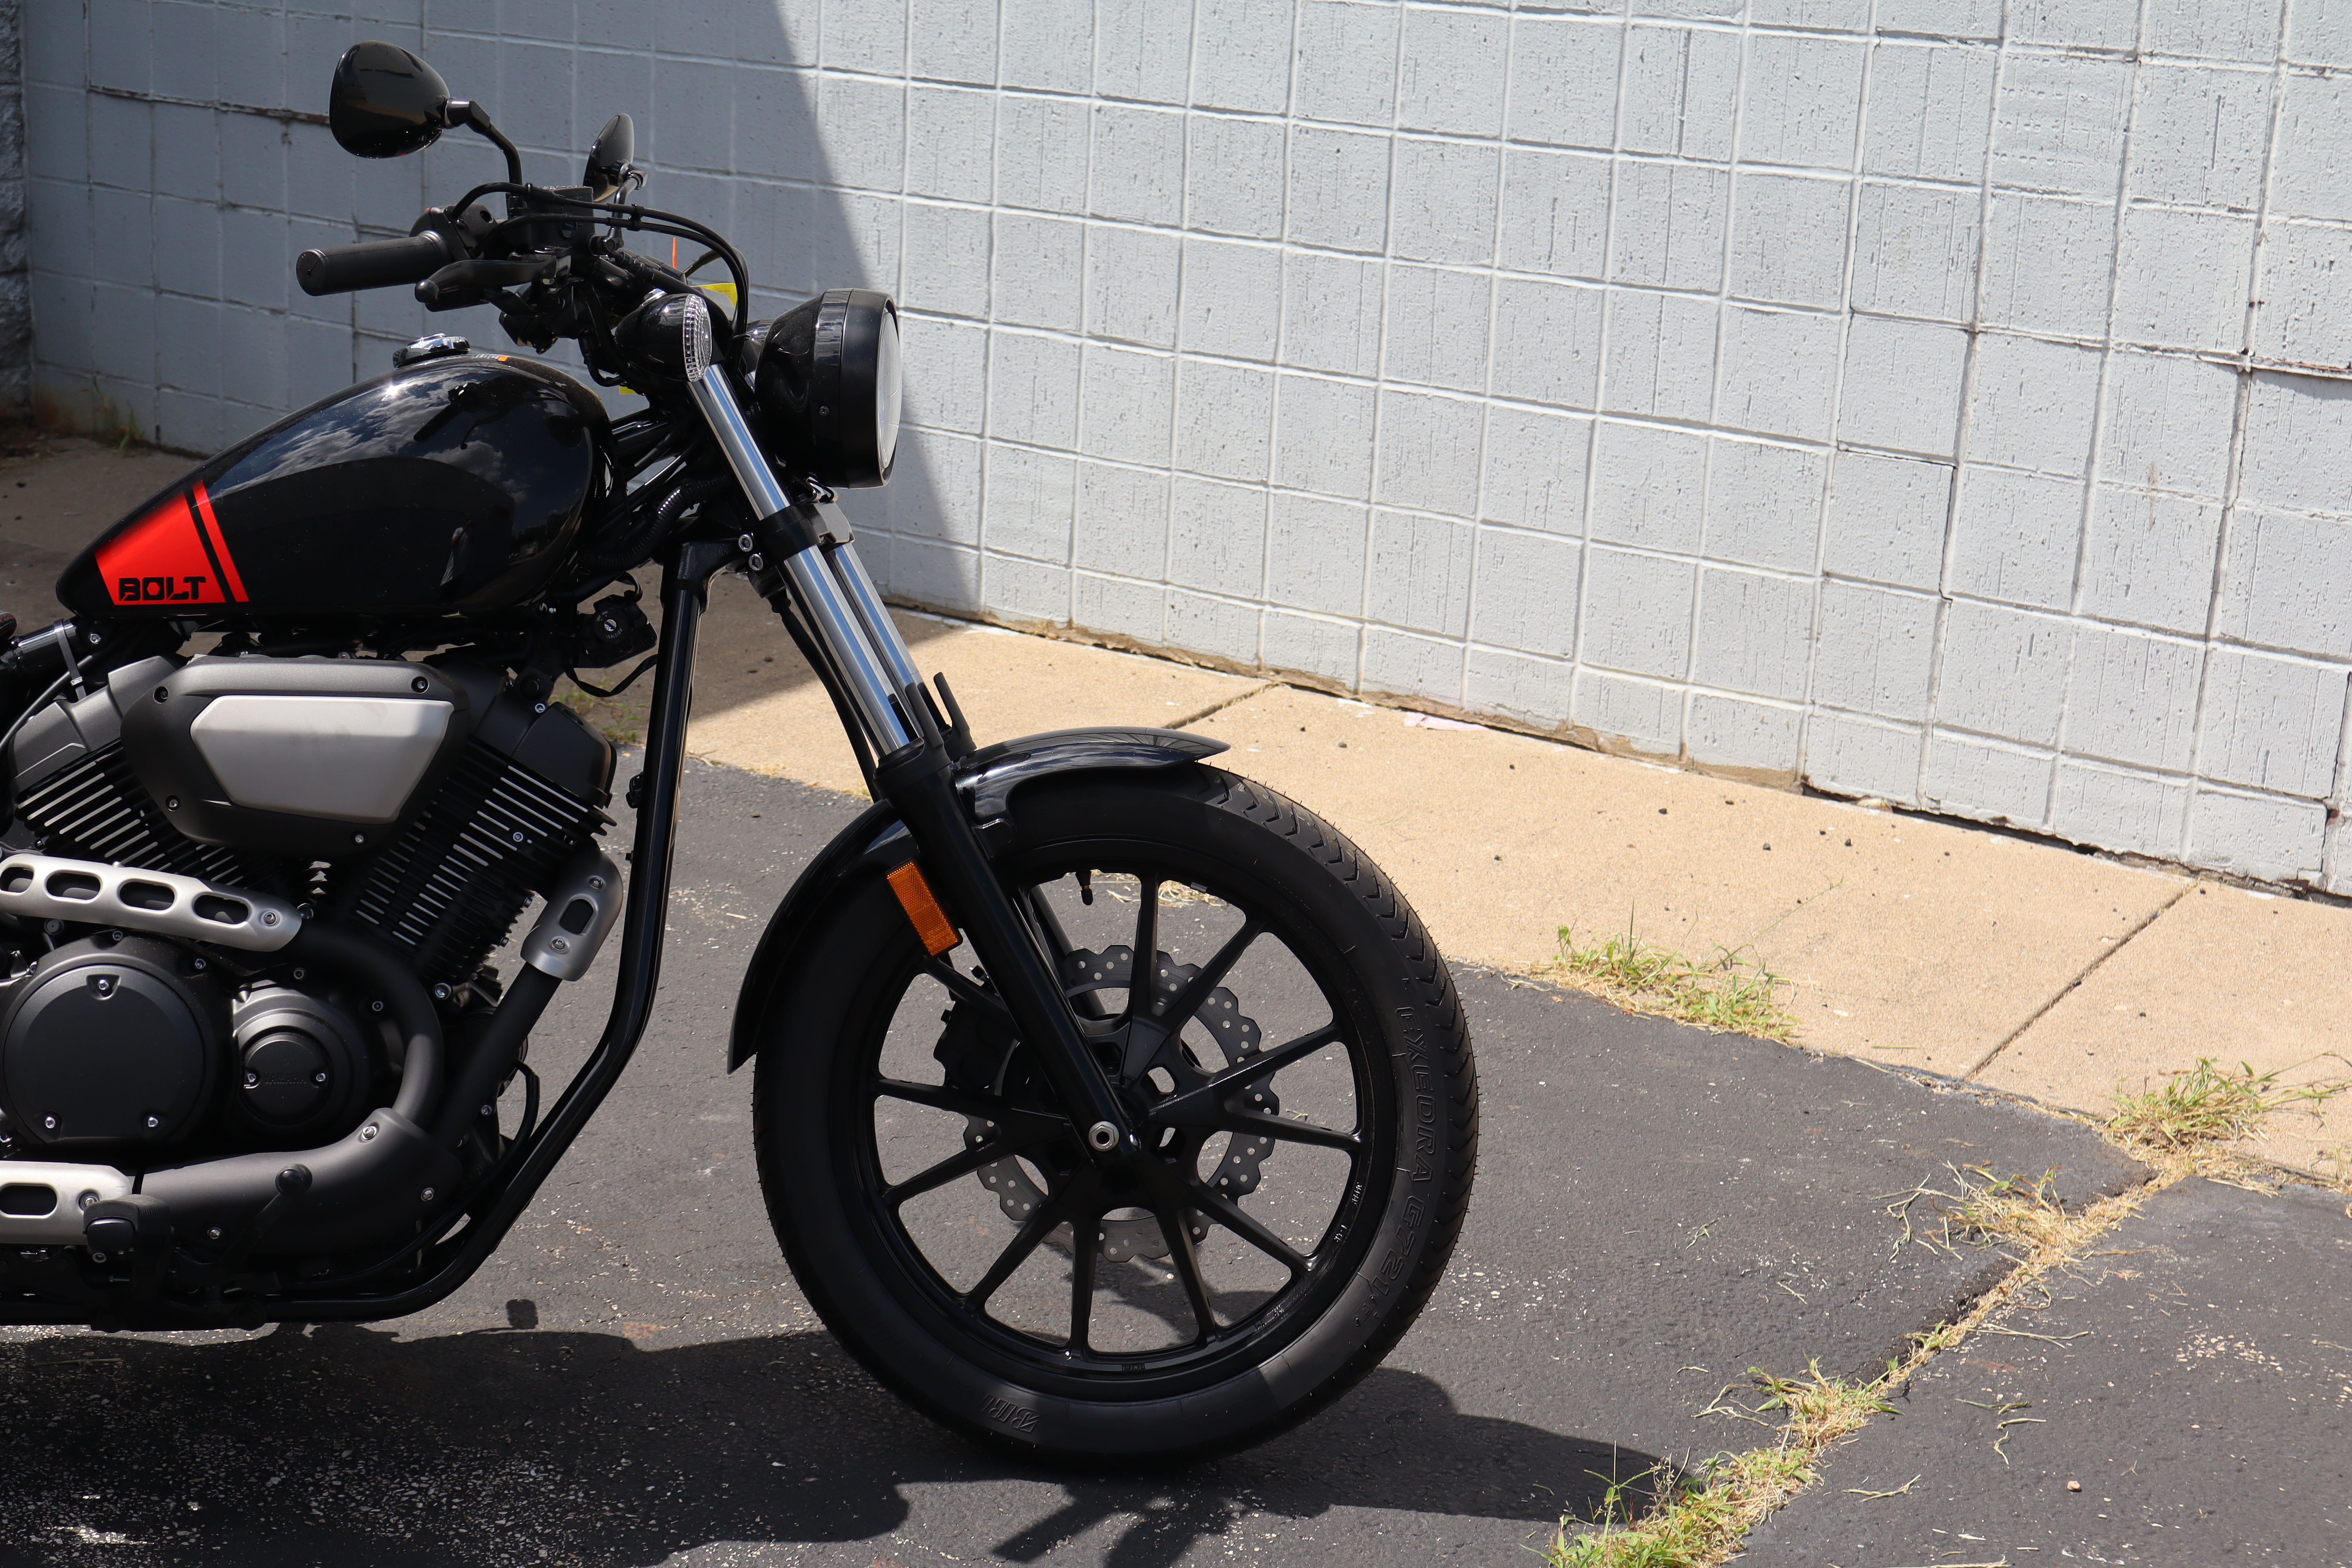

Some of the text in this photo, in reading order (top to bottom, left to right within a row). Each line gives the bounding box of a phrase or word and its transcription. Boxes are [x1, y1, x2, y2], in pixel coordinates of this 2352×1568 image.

[119, 576, 206, 601] BOLT
[605, 628, 622, 639] IGNITION
[264, 1073, 307, 1084] YAMAHA
[1371, 1006, 1437, 1298] EXEDRA G721
